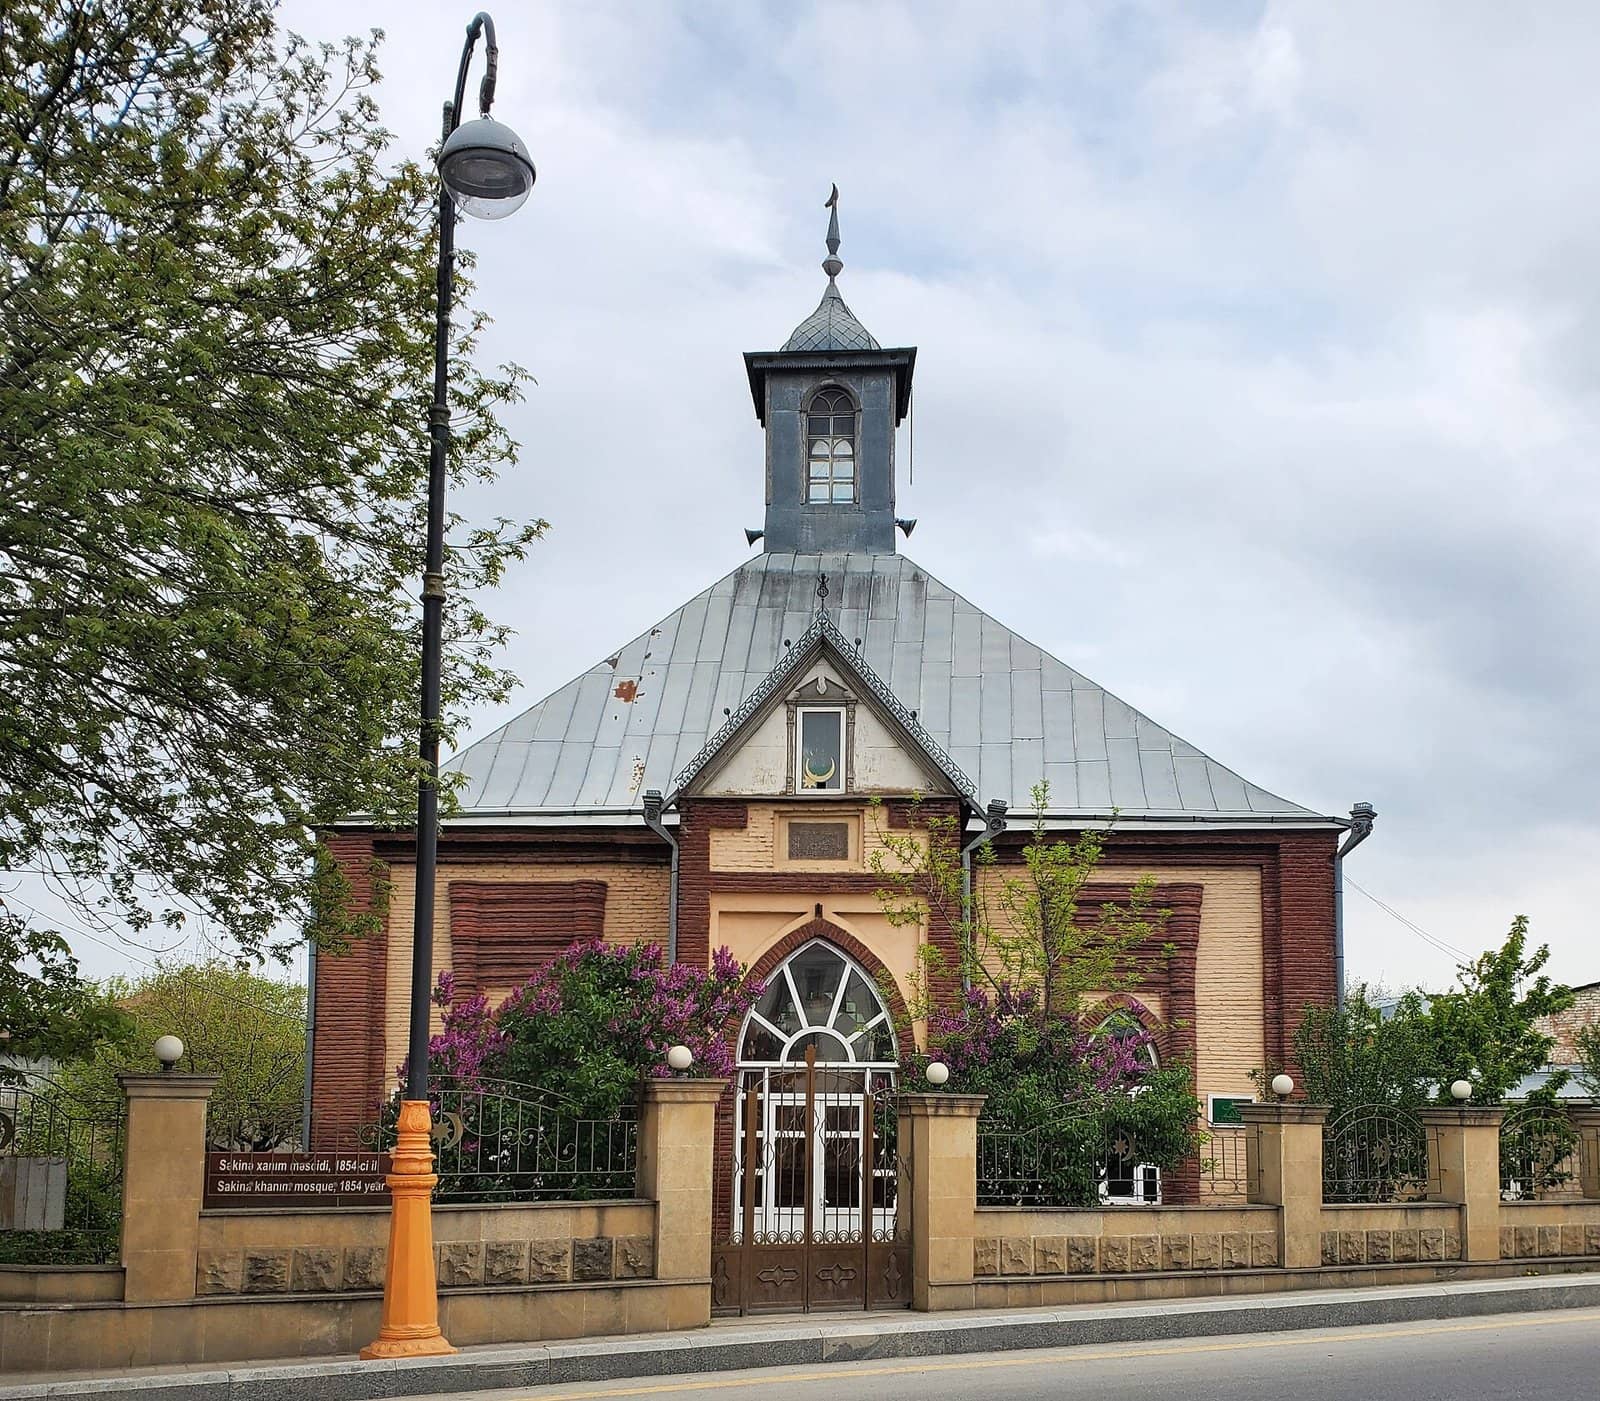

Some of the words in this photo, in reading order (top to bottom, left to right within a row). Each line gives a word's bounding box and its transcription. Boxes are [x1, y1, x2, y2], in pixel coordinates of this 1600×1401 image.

[256, 1161, 287, 1171] xanım
[371, 1159, 378, 1171] il
[217, 1180, 252, 1192] Sakina
[294, 1182, 337, 1194] mosque,
[340, 1180, 362, 1192] 1854
[363, 1182, 386, 1194] year
